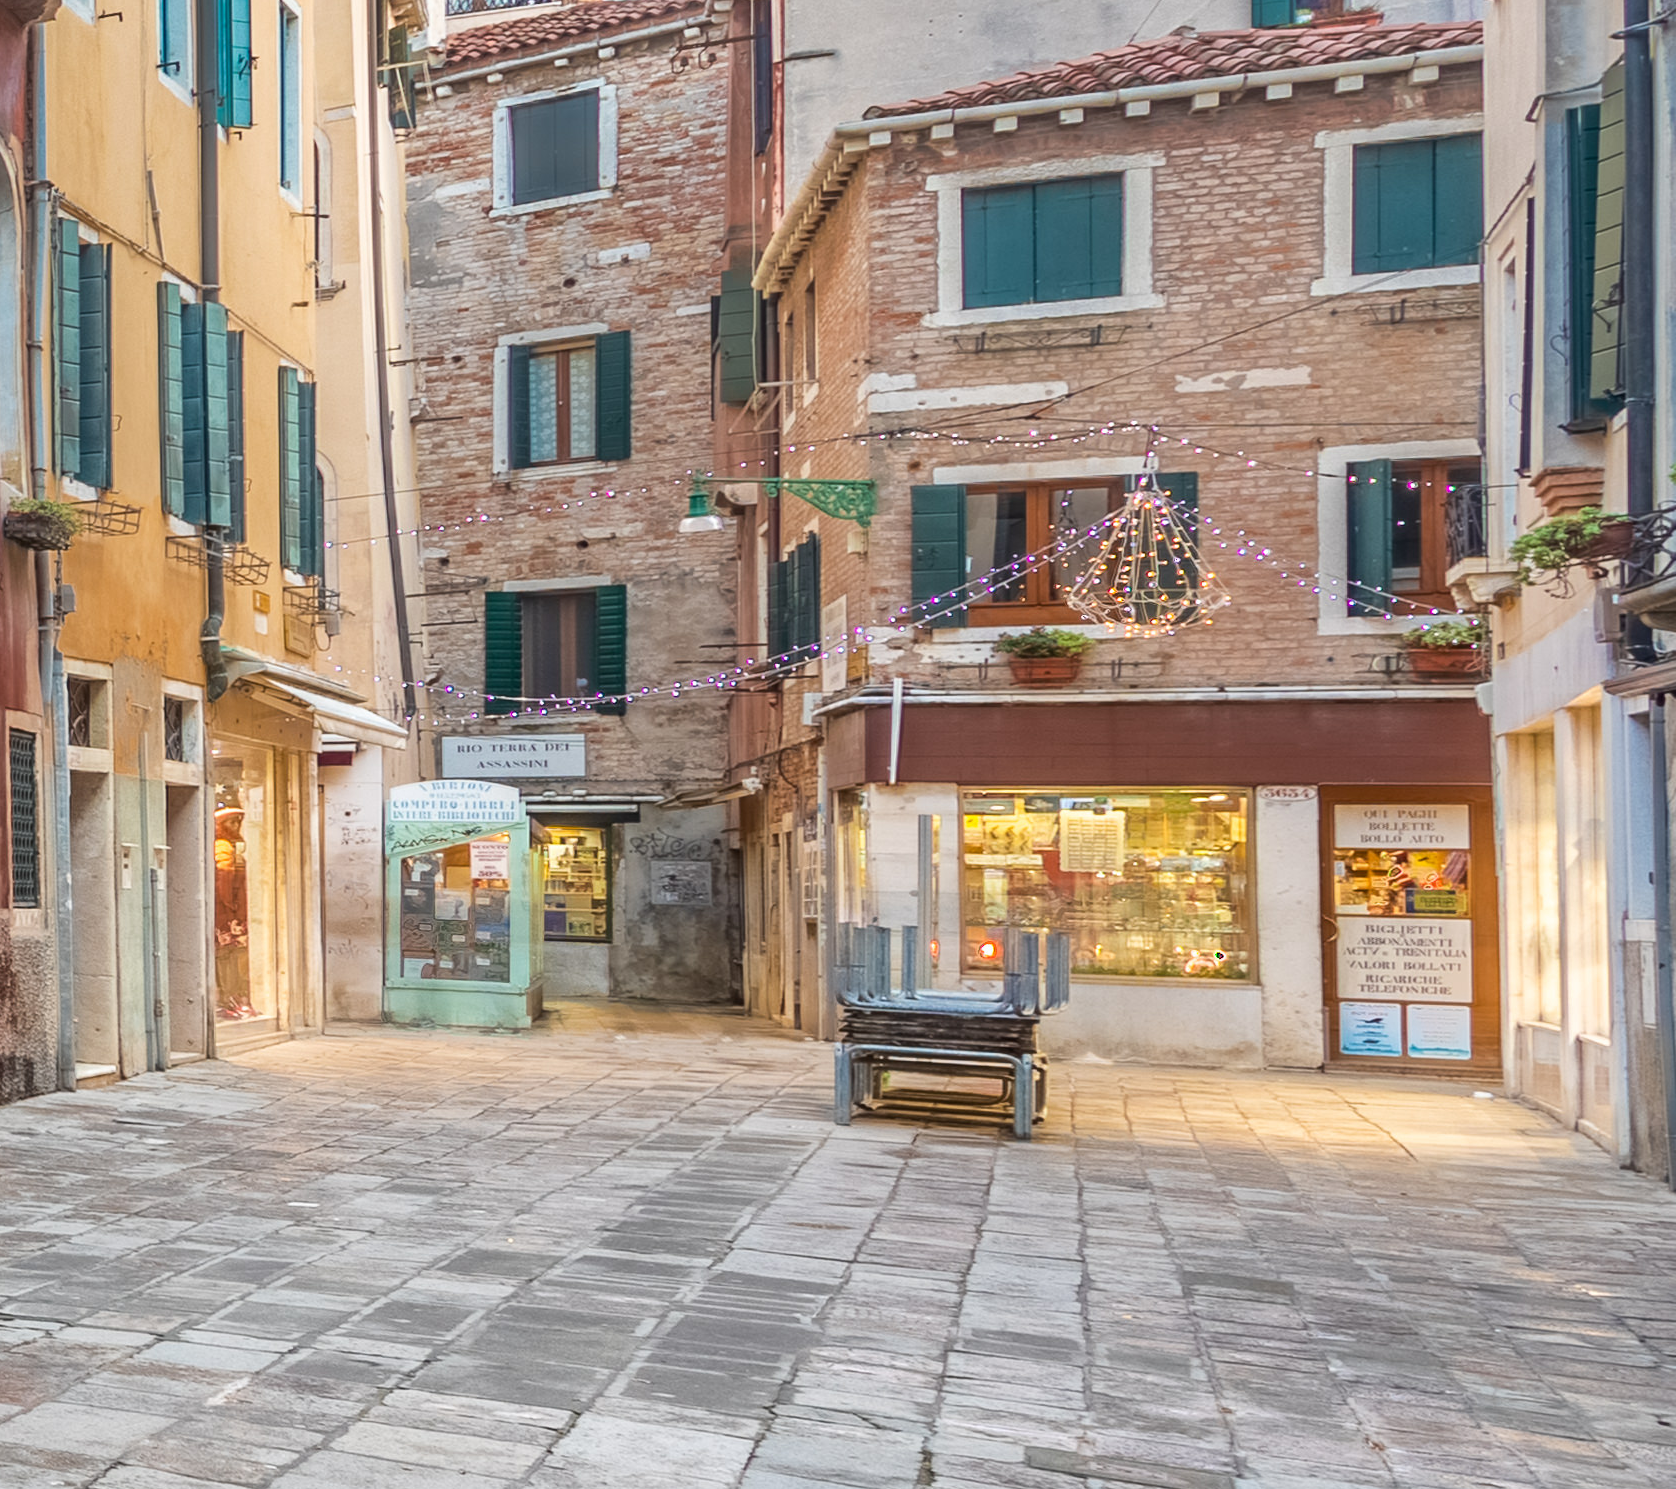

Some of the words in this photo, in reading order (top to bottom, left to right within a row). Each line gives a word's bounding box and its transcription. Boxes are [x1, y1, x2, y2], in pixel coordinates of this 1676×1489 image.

[457, 744, 482, 753] RIO
[545, 743, 570, 752] DEI
[477, 760, 548, 769] ASSASSINI
[1363, 810, 1387, 819] QUI
[1397, 810, 1437, 819] PAGHI
[1369, 822, 1435, 831] BOLLETTE
[1360, 834, 1402, 843] BOLLO
[1409, 834, 1444, 844] AUTO
[1365, 924, 1443, 934] BIGLIETTI
[1357, 937, 1452, 948] ABBONAMENTI
[1343, 947, 1380, 956] ACTV
[1394, 948, 1467, 959] TRENITALIA
[1346, 960, 1396, 970] VALORI
[1403, 961, 1462, 971] BOLLATI
[1365, 974, 1443, 985] RICARICHE
[1358, 984, 1452, 996] TELEFONICHE
